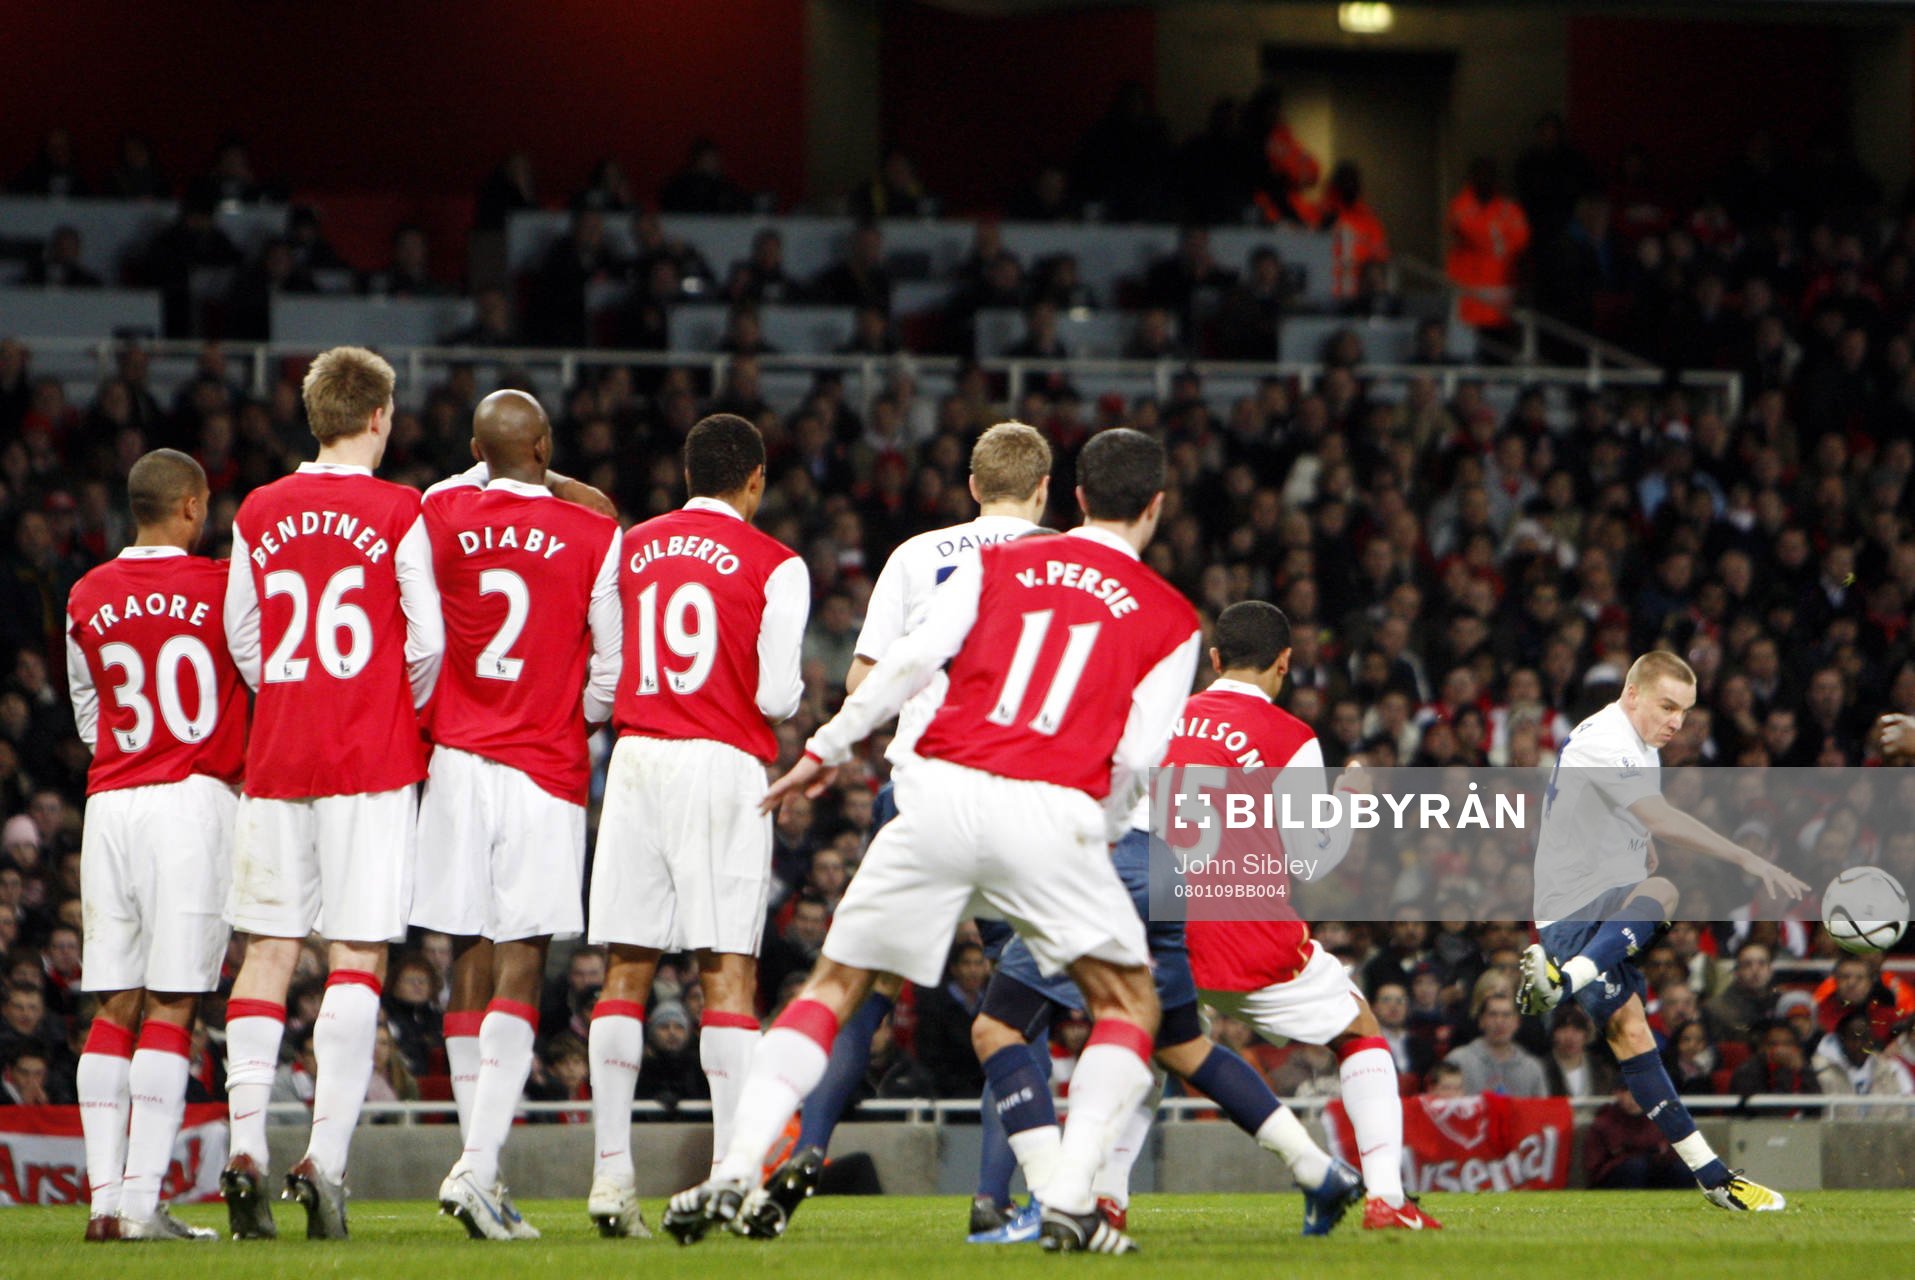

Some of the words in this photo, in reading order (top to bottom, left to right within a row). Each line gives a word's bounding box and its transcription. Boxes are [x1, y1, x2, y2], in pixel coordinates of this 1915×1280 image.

[251, 510, 389, 569] BENDTNER
[457, 526, 566, 560] DIABY
[630, 536, 740, 575] GILBERTO
[89, 592, 210, 636] TRAORE
[264, 566, 373, 684] 26
[475, 568, 531, 682] 2
[637, 582, 718, 696] 19
[98, 634, 219, 753] 30
[986, 608, 1103, 737] 11
